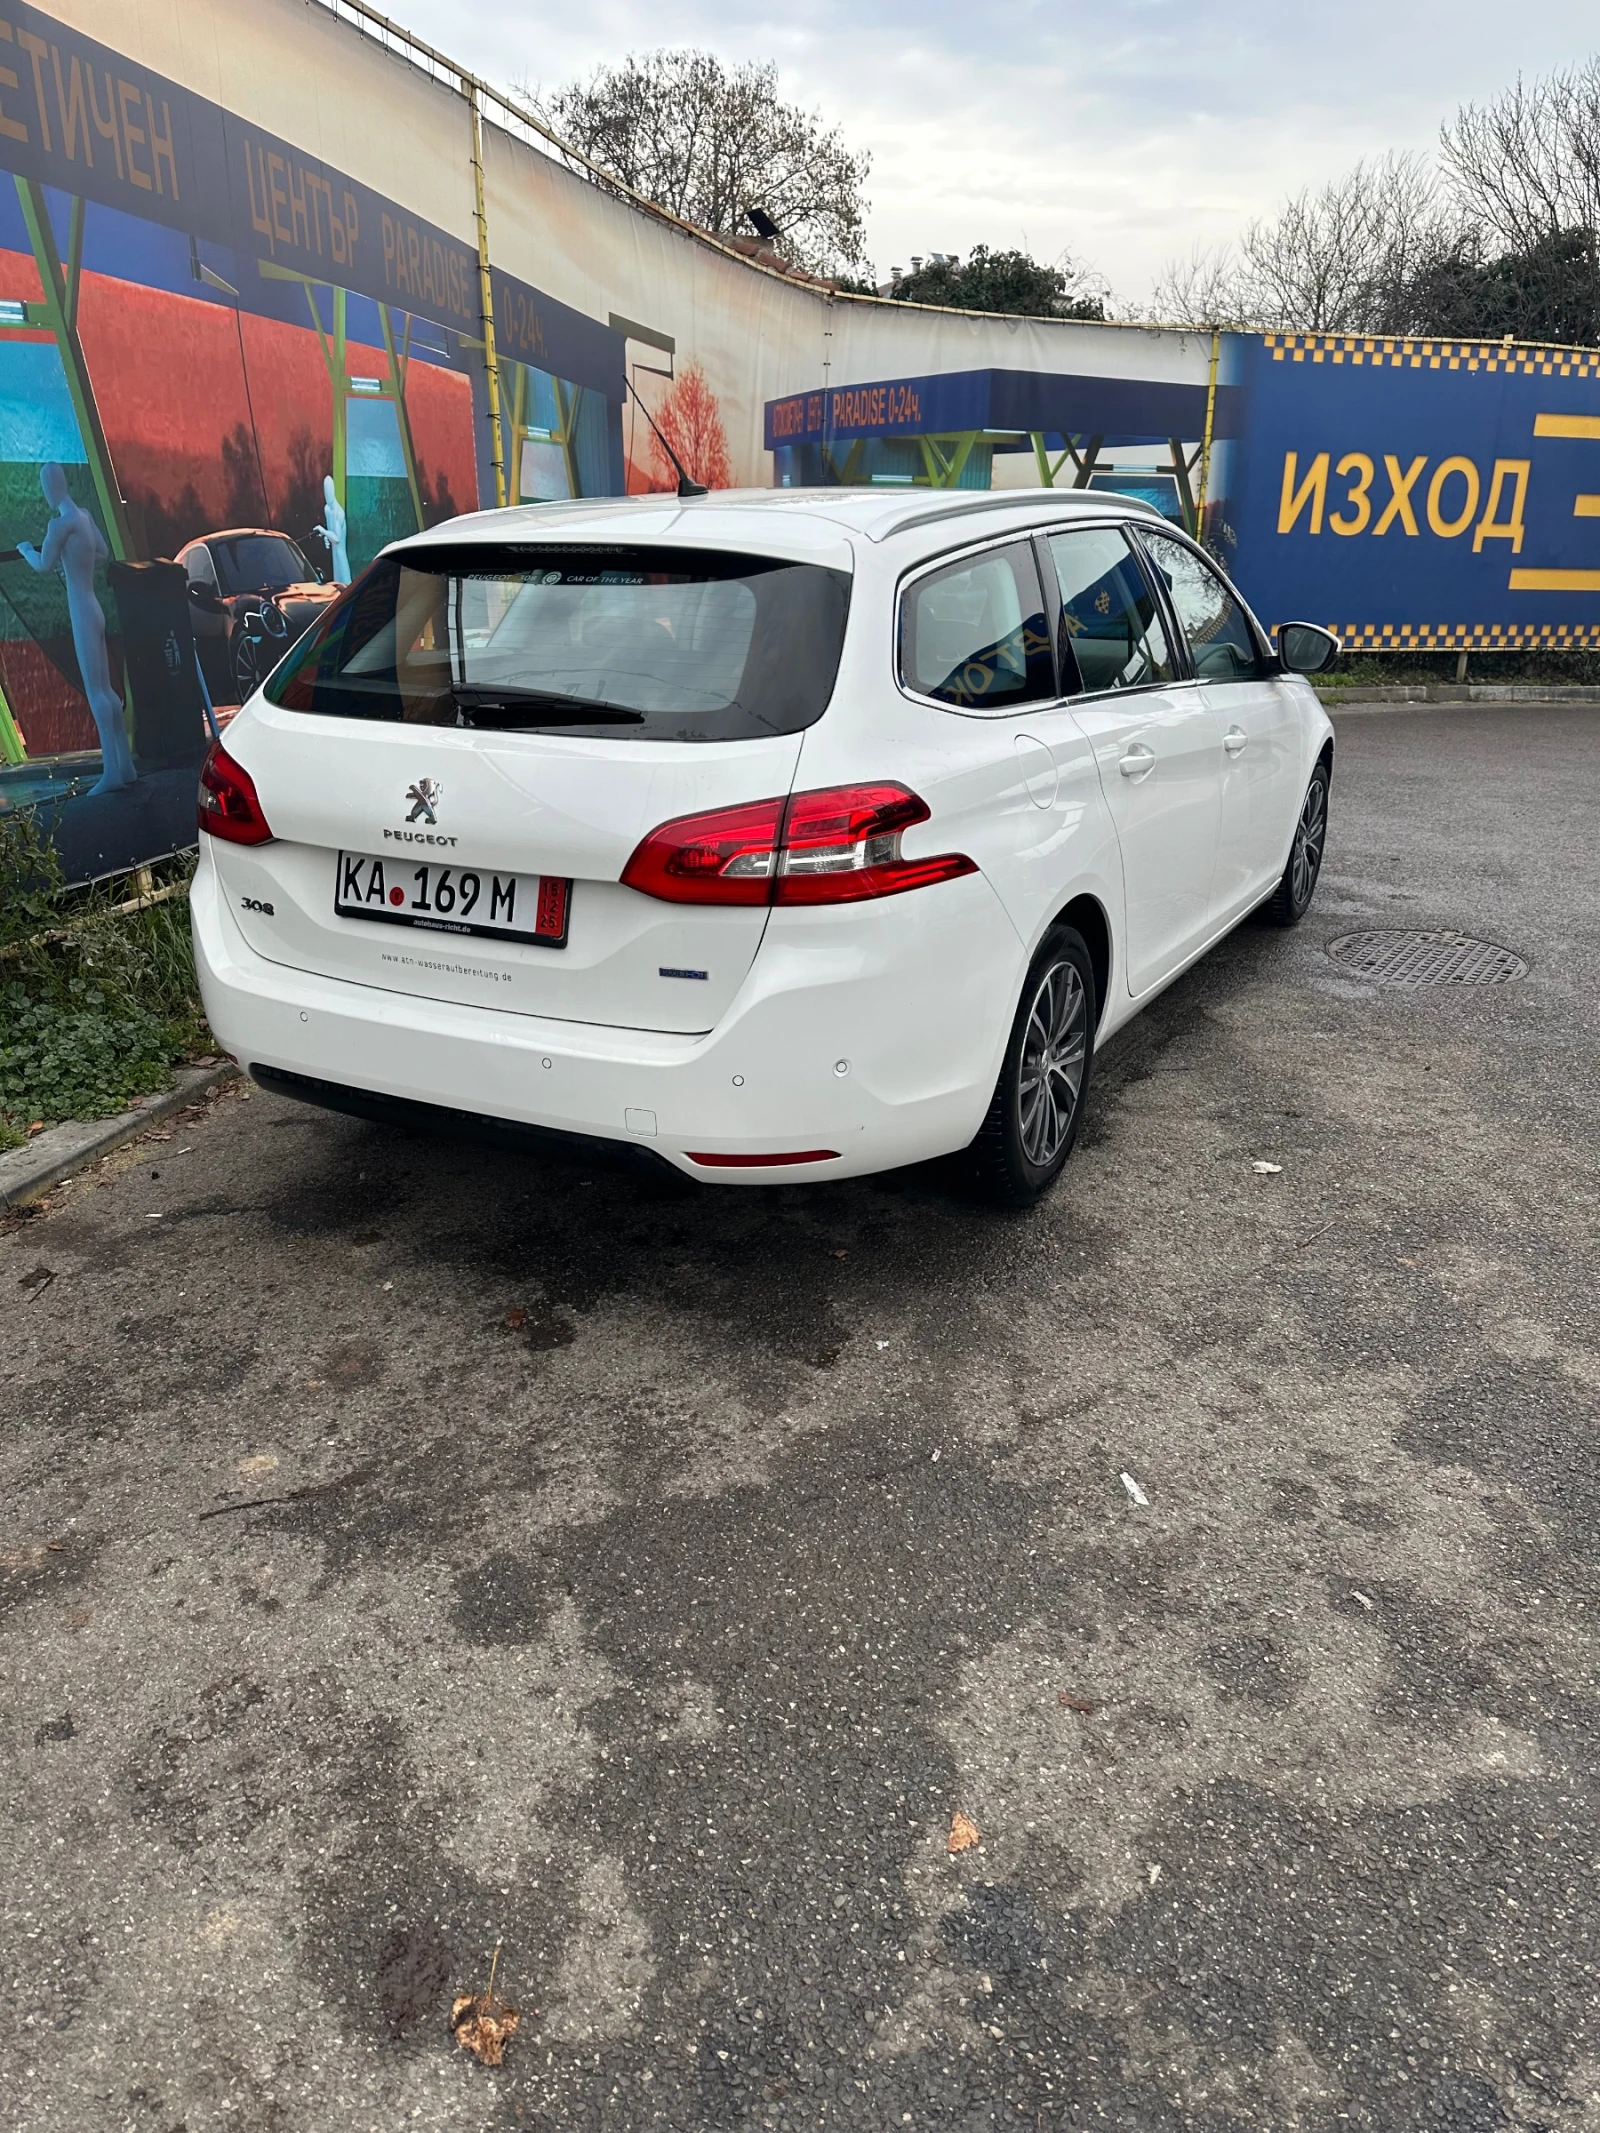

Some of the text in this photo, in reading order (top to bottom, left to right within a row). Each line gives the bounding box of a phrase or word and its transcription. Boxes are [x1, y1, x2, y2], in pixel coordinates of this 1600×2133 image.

[244, 140, 359, 268] ЦЕНТЪР
[382, 212, 471, 320] PARADISE
[833, 388, 886, 428] PARADISE
[1277, 451, 1531, 553] ИЗХОД
[566, 575, 585, 583] CAR
[600, 576, 618, 584] THE
[620, 577, 644, 585] YEAR
[383, 829, 458, 847] PEUGEOT
[343, 857, 516, 922] KA 169 M
[544, 883, 560, 897] 15
[241, 897, 275, 916] 308
[542, 899, 558, 913] 12
[413, 919, 471, 933] autohaus-richt.de
[540, 914, 557, 929] 25
